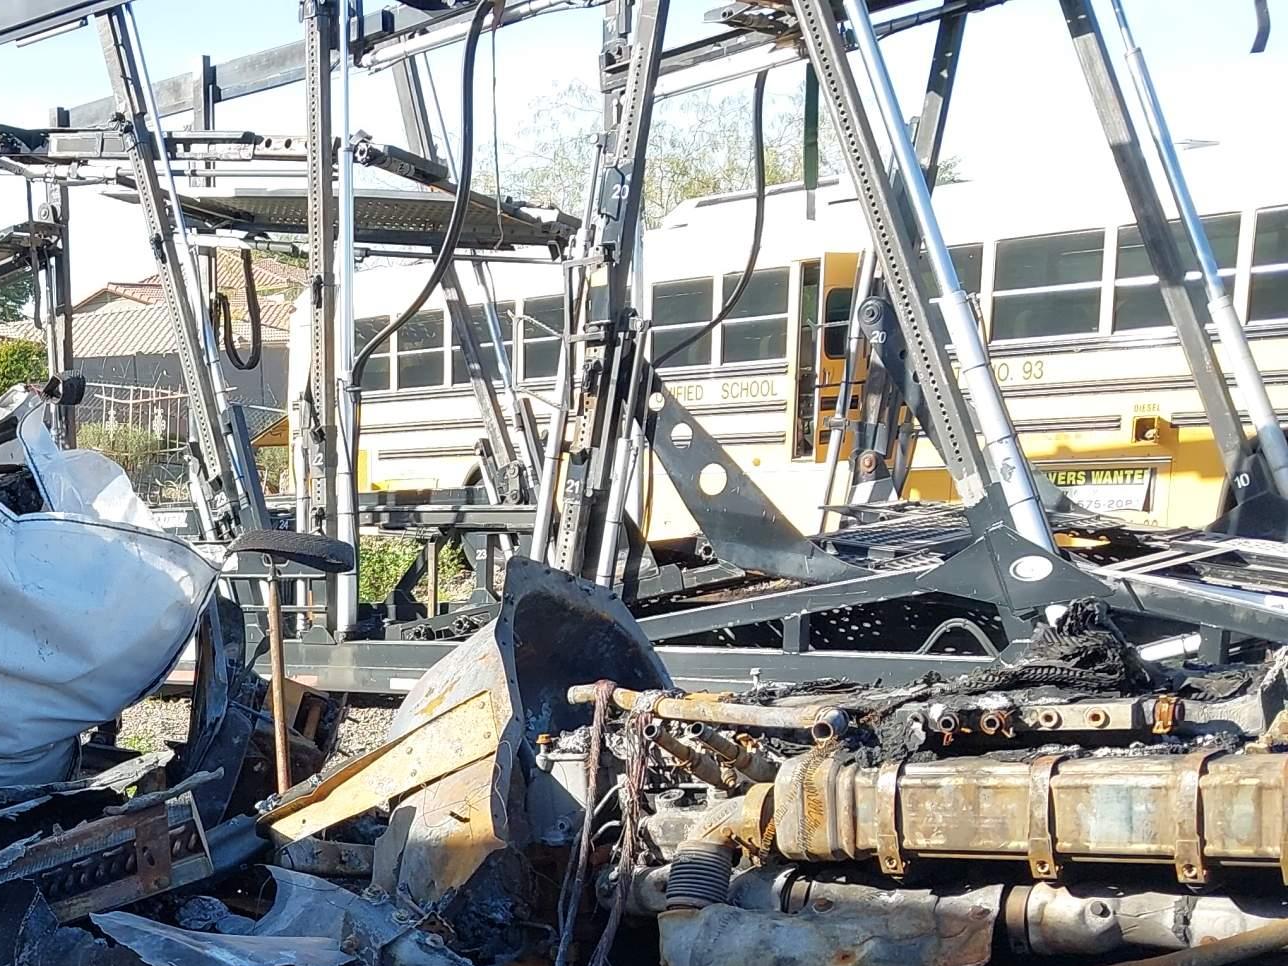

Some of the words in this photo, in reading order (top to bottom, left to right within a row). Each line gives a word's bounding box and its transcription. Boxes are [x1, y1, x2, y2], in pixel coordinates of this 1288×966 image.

[612, 184, 629, 199] 20
[870, 331, 886, 344] 20
[1022, 360, 1044, 380] 93
[655, 384, 704, 403] UIFIED
[721, 379, 778, 400] SCHOOL
[1134, 404, 1160, 413] DIESEL
[1046, 470, 1087, 485] VERS
[1091, 468, 1148, 485] WANTE
[1234, 473, 1250, 489] 10
[565, 479, 580, 494] 21
[279, 519, 289, 530] 24
[475, 549, 487, 560] 23
